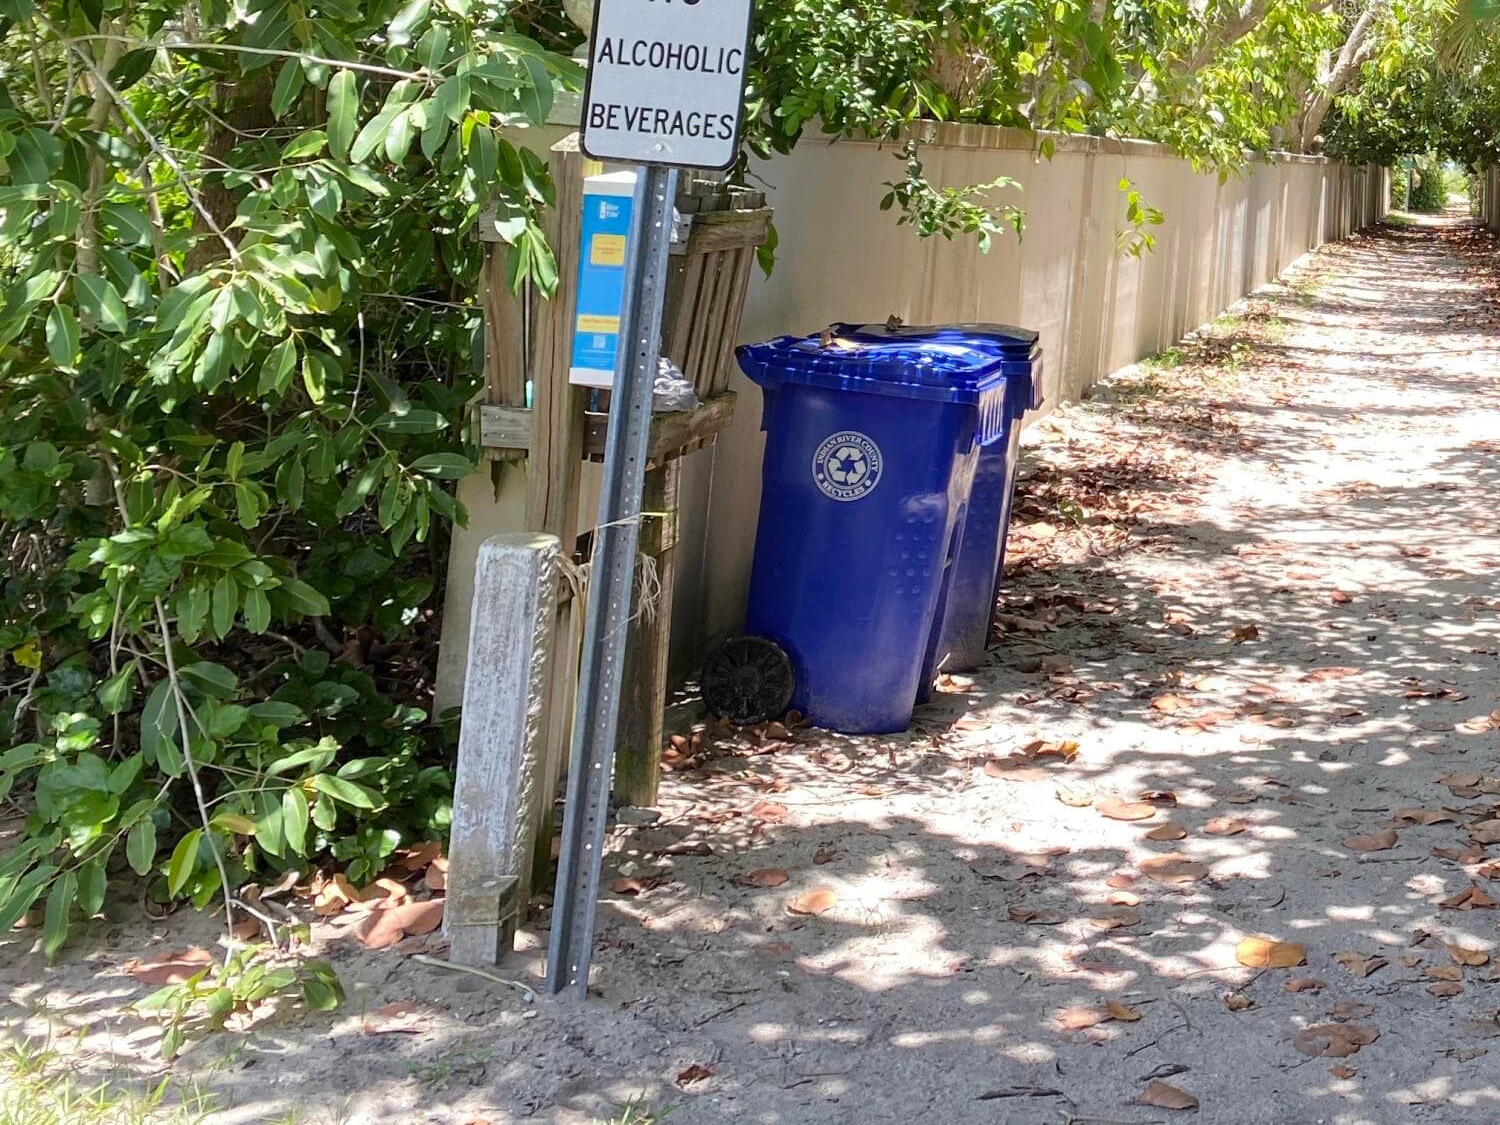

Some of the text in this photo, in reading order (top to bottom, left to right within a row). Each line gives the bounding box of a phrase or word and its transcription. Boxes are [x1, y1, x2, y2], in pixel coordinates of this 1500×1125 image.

[597, 37, 742, 75] ALCOHOLIC
[589, 103, 735, 140] BEVERAGES
[817, 435, 879, 473] INDIAN RIVER COUNTY
[822, 481, 865, 498] RECYCLES
